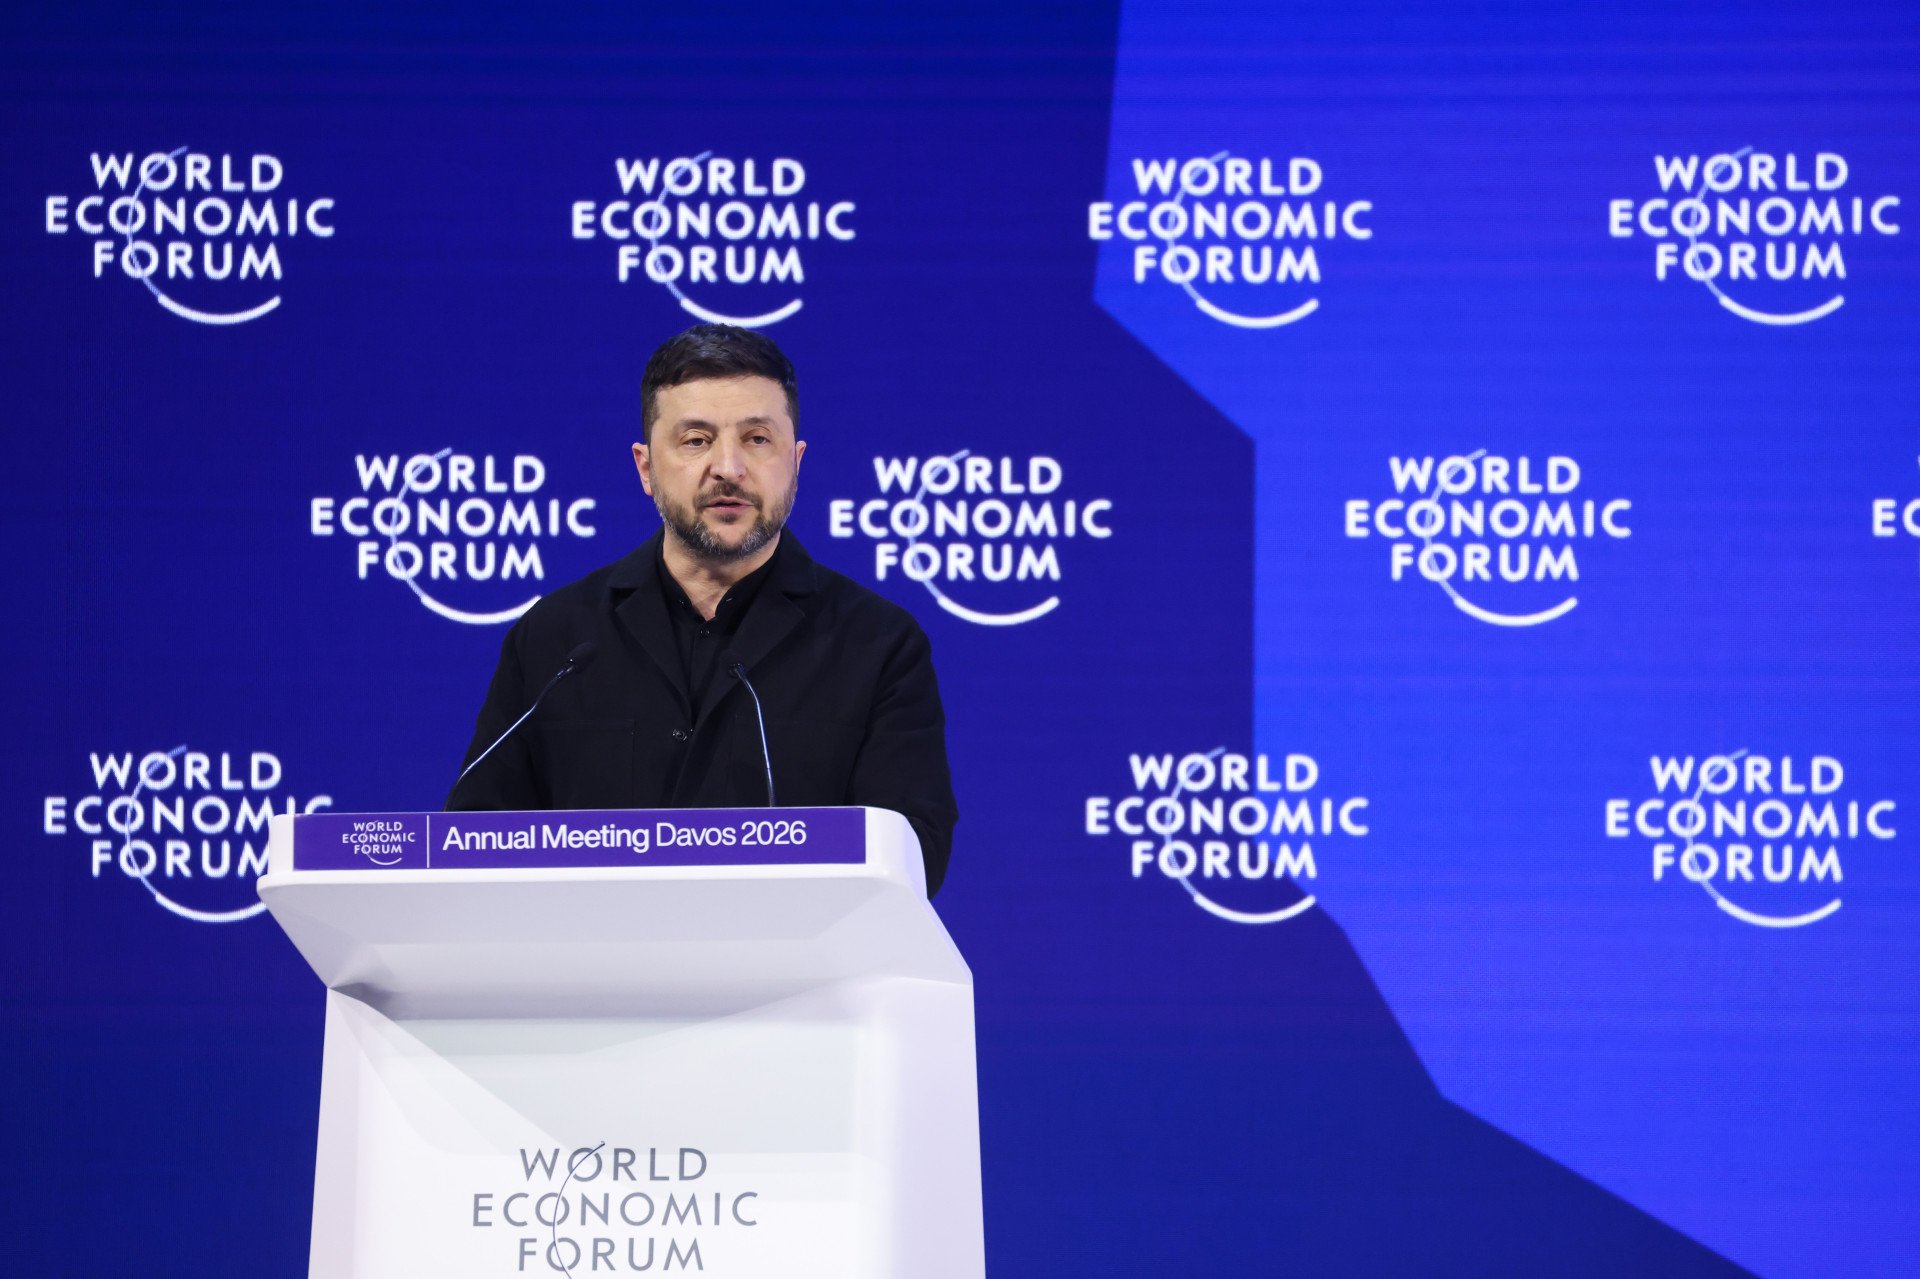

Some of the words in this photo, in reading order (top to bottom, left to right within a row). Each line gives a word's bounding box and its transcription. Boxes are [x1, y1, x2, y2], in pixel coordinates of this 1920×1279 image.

[91, 153, 282, 191] WORLD
[616, 157, 805, 195] WORLD
[1133, 157, 1322, 195] WORLD
[1655, 152, 1848, 191] WORLD
[46, 195, 333, 236] ECONOMIC
[572, 200, 855, 240] ECONOMIC
[1089, 200, 1372, 240] ECONOMIC
[1610, 197, 1899, 237] ECONOMIC
[95, 241, 281, 279] FORUM
[619, 244, 803, 283] FORUM
[1135, 245, 1320, 283] FORUM
[1656, 242, 1846, 281] FORUM
[355, 454, 545, 492] WORLD
[874, 455, 1062, 494] WORLD
[1389, 455, 1580, 494] WORLD
[311, 497, 595, 536] ECONOMIC
[830, 499, 1111, 538] ECONOMIC
[1345, 499, 1631, 538] ECONOMIC
[359, 541, 543, 580] FORUM
[876, 542, 1060, 581] FORUM
[1392, 543, 1579, 582] FORUM
[90, 752, 281, 790] WORLD
[1130, 753, 1318, 792] WORLD
[1650, 755, 1843, 794] WORLD
[353, 821, 403, 832] WORLD
[1086, 797, 1368, 836] ECONOMIC
[1606, 799, 1896, 838] ECONOMIC
[342, 832, 415, 844] ECONOMIC
[354, 844, 403, 854] FORUM
[442, 825, 536, 850] Annual
[542, 824, 650, 854] Meeting
[656, 822, 737, 847] Davos
[740, 820, 807, 846] 2026
[92, 840, 270, 878] FORUM
[1132, 840, 1317, 879] FORUM
[1653, 842, 1843, 883] FORUM
[519, 1147, 707, 1182] WORLD
[472, 1191, 759, 1227] ECONOMIC
[518, 1237, 704, 1271] FORUM
